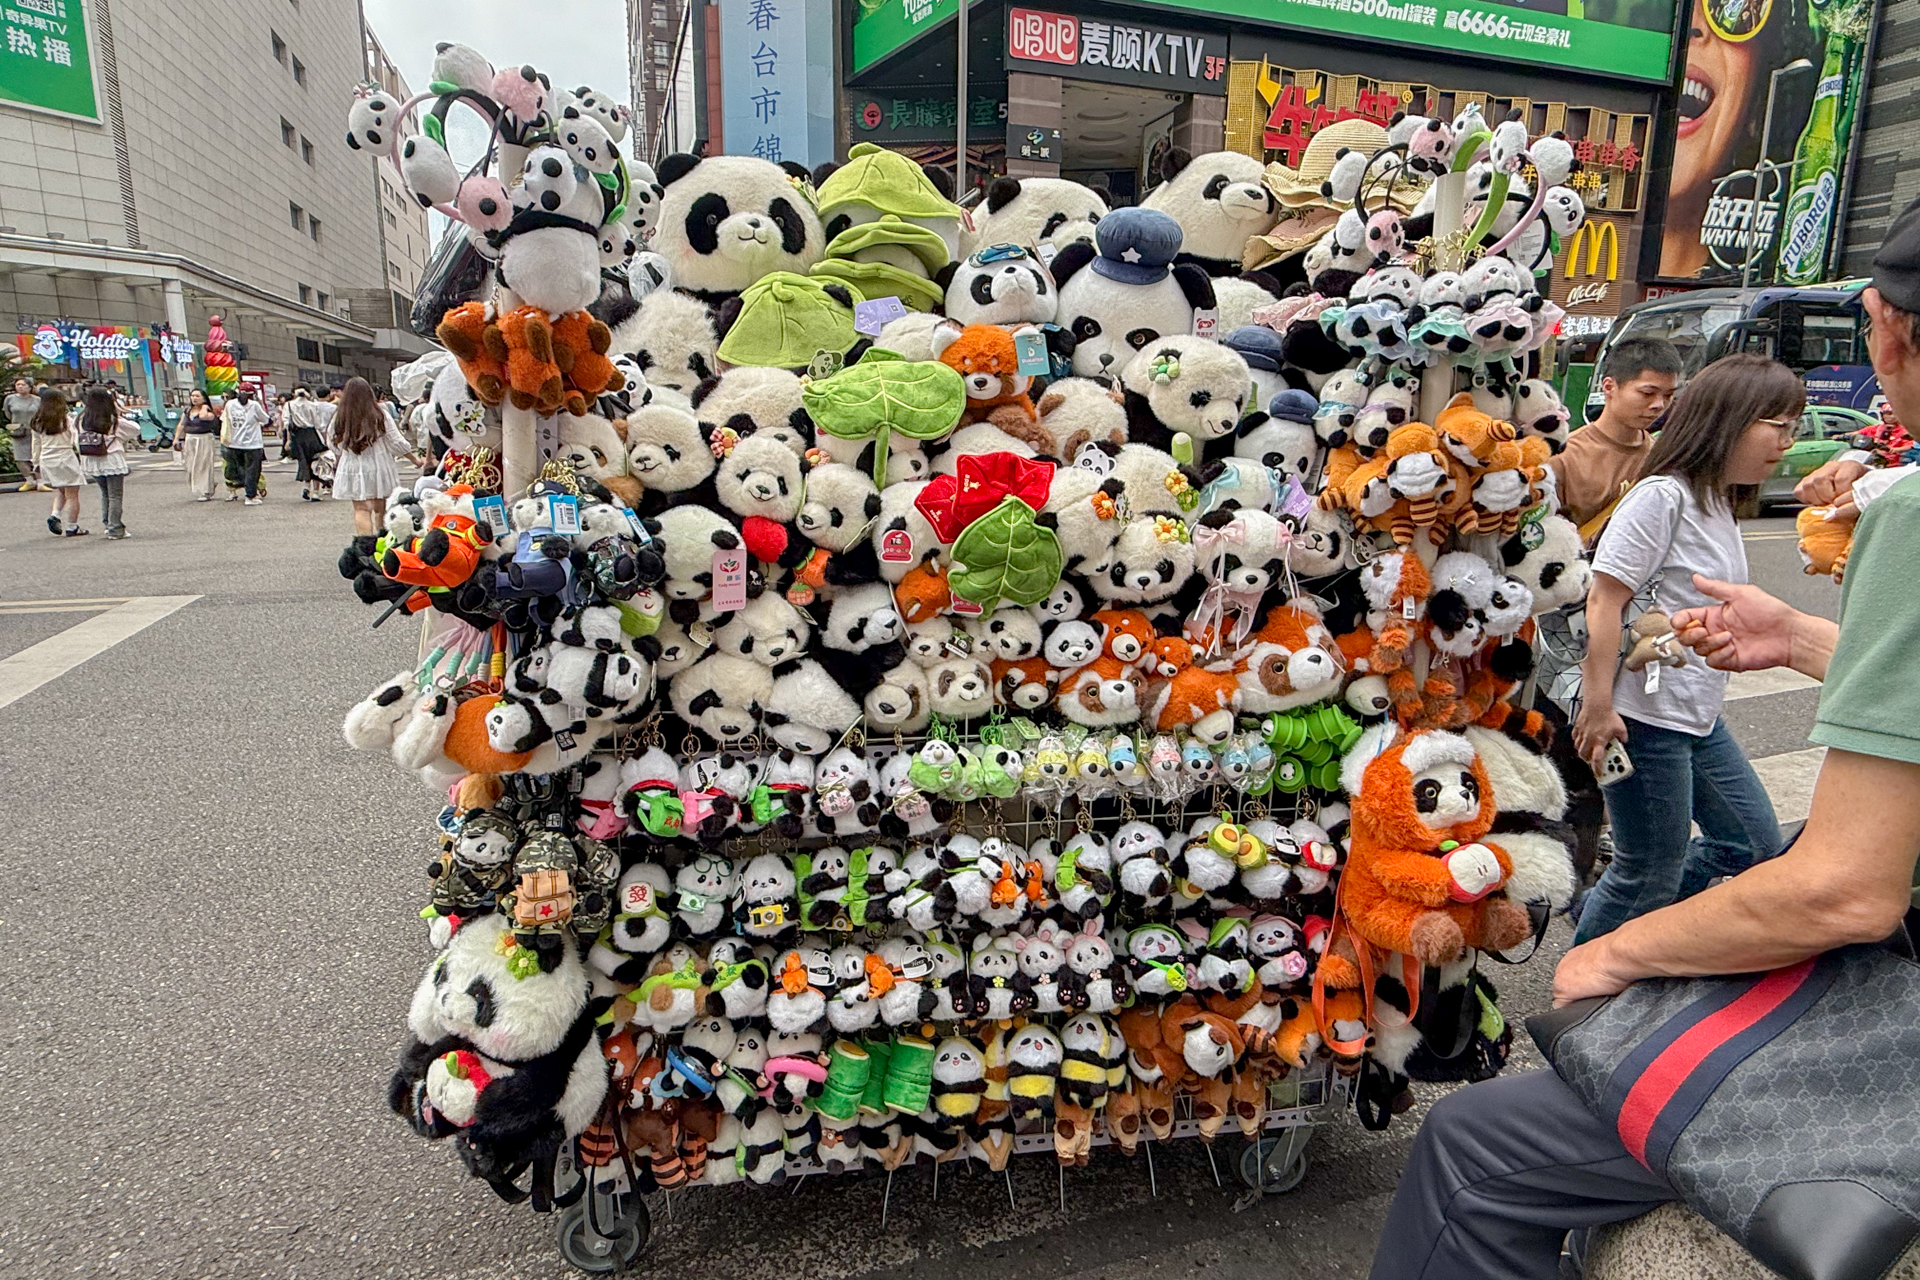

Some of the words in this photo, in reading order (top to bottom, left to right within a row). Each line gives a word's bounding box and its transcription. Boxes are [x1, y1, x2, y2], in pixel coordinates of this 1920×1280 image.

[5, 8, 67, 35] 奇异果TV
[1443, 9, 1571, 48] 赢6666元现金豪礼
[6, 26, 72, 67] 热播
[1204, 55, 1226, 81] 3F
[1567, 134, 1642, 172] 串串香
[1700, 227, 1738, 248] WHY
[1782, 194, 1827, 268] TUBORG
[69, 328, 140, 351] Holdice
